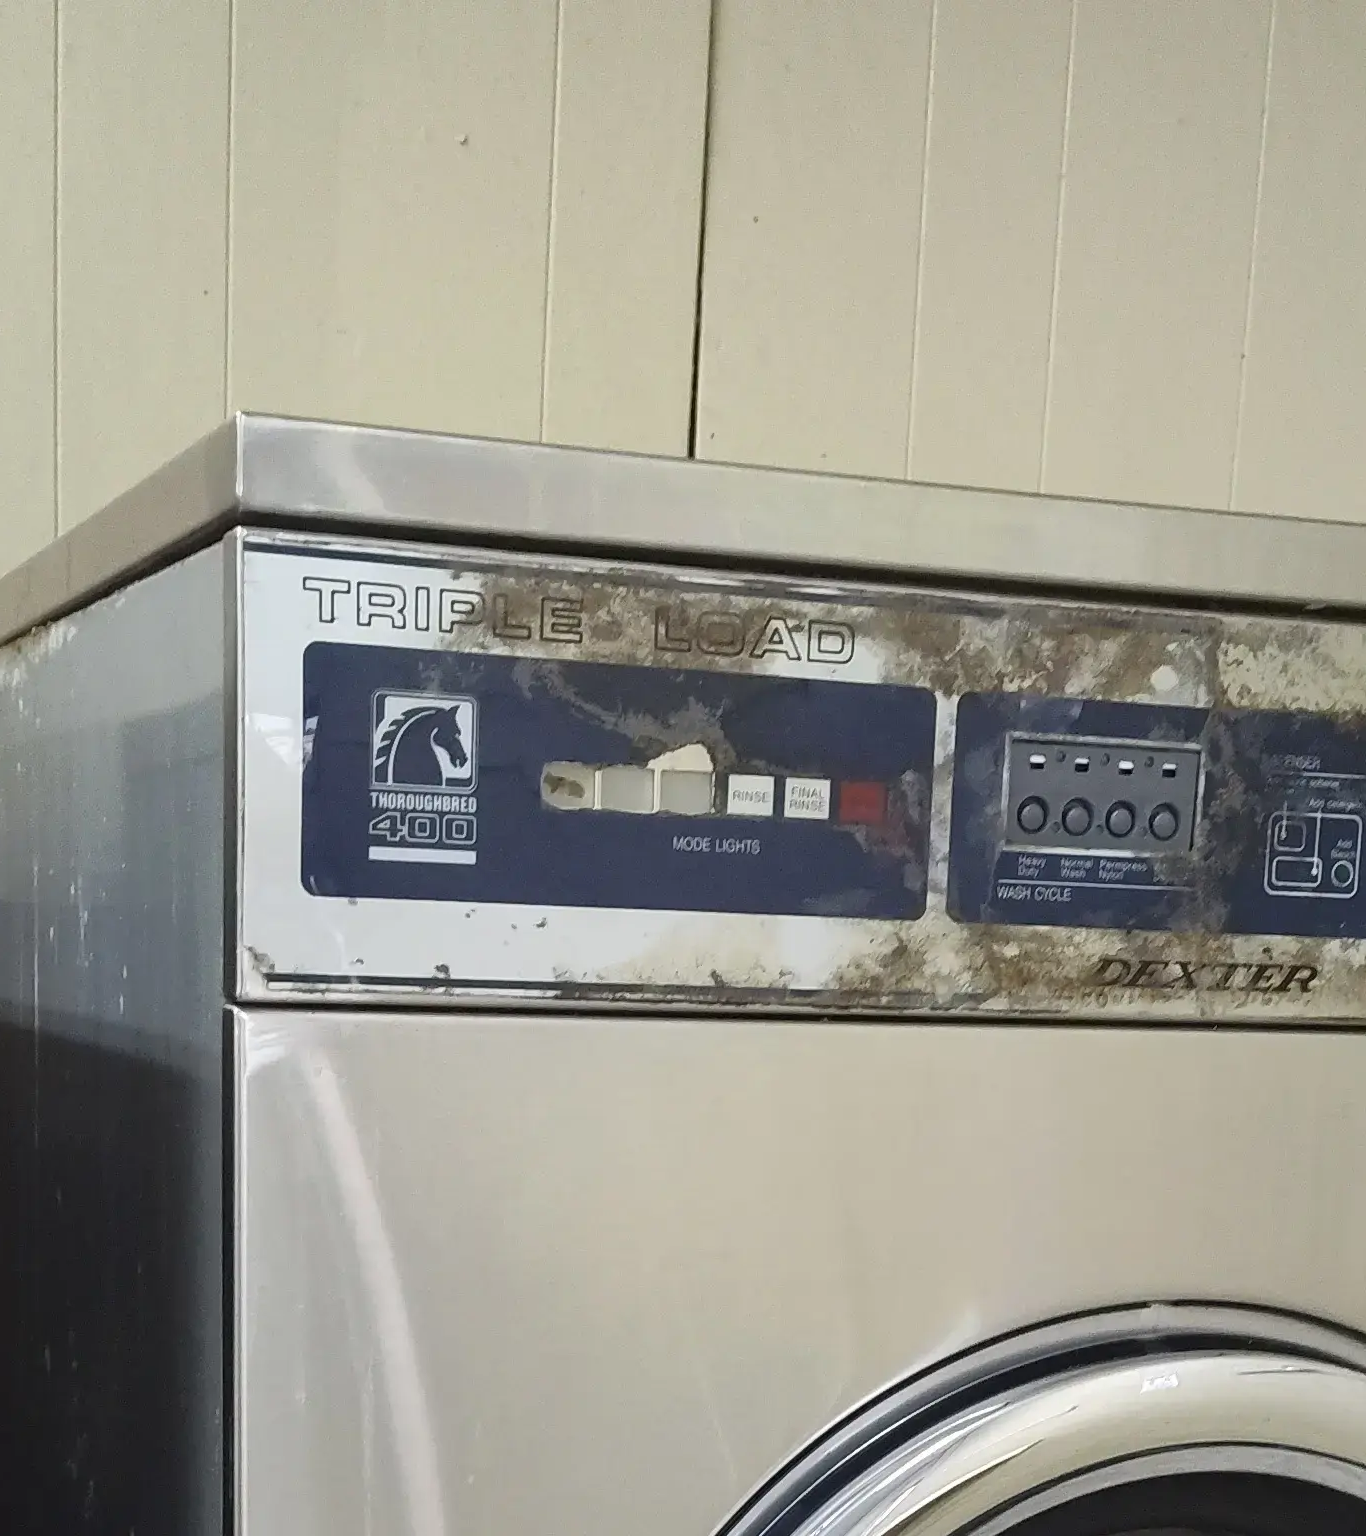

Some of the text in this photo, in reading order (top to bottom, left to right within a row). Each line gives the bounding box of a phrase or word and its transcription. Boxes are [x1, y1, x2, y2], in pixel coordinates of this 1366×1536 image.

[302, 576, 856, 665] TRIPLE LOAD
[731, 789, 771, 803] RINSE
[790, 785, 825, 799] FINAL
[369, 791, 477, 813] THOROUGHBRED
[788, 799, 826, 813] RINSE
[368, 811, 477, 845] 400
[672, 836, 761, 855] MODE LIGHTS
[996, 885, 1072, 902] WASH CYCLE
[1090, 955, 1319, 994] DEXTER
